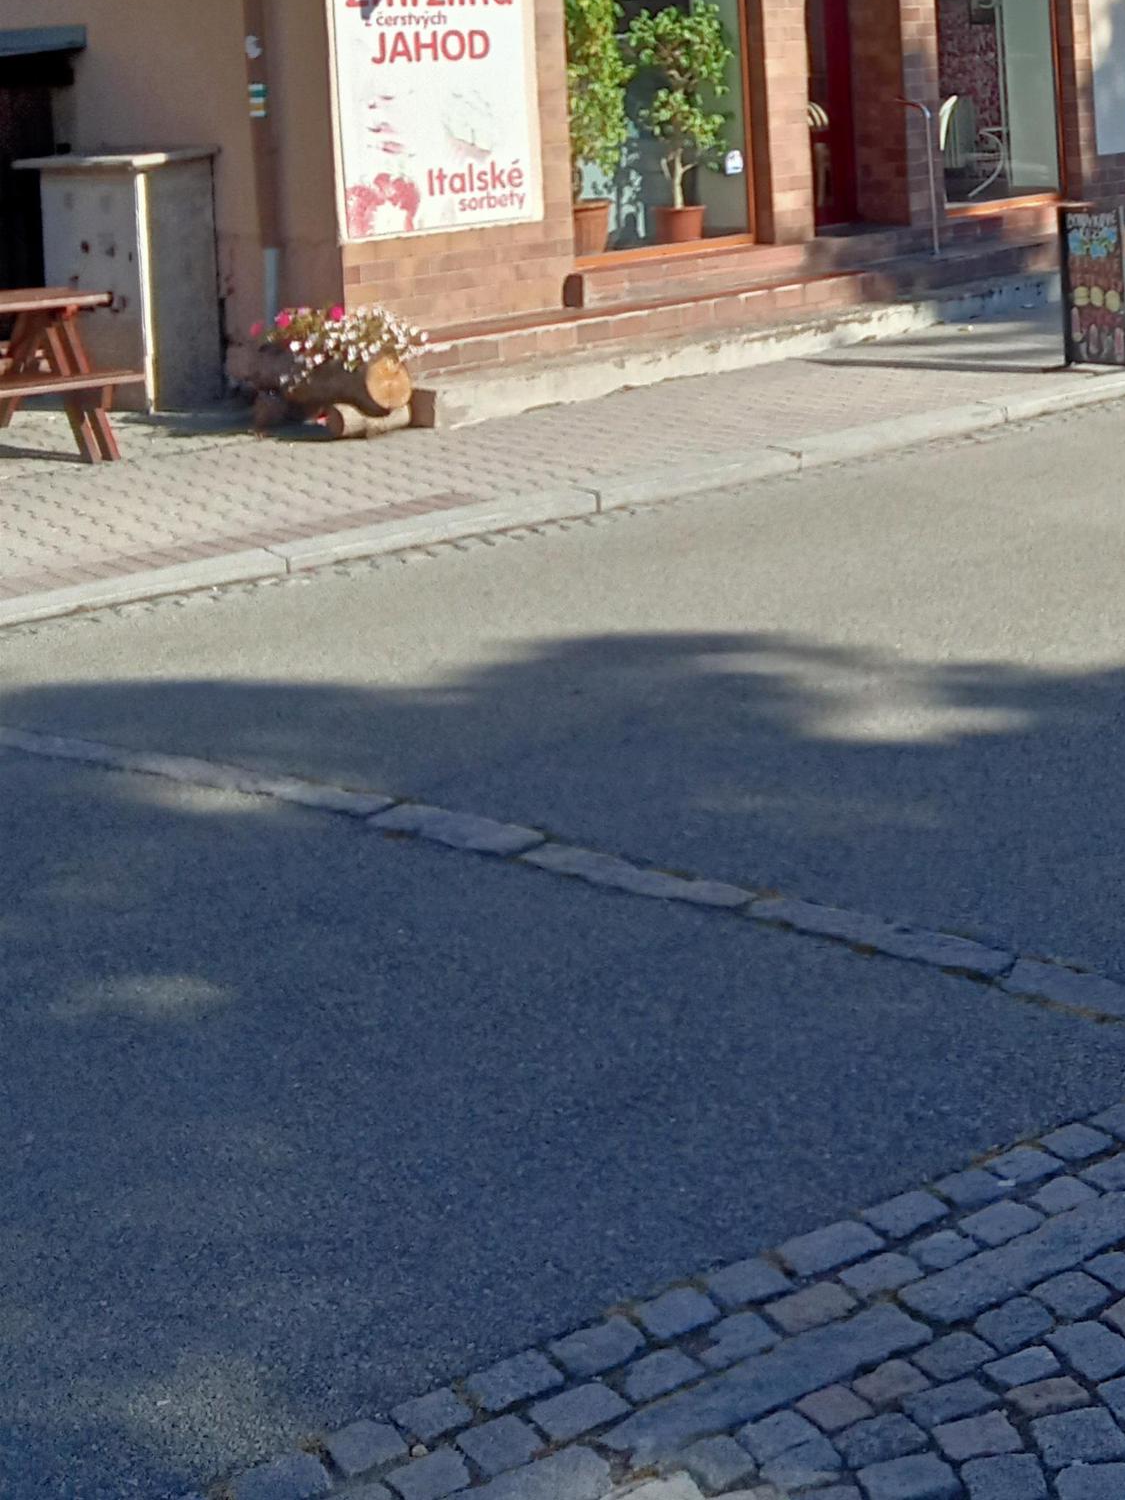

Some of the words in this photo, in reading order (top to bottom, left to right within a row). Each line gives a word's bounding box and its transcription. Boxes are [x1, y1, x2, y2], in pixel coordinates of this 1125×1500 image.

[375, 10, 448, 29] čerstvých
[371, 30, 491, 64] JAHOD
[428, 158, 524, 197] Italské
[458, 190, 526, 212] sorbety
